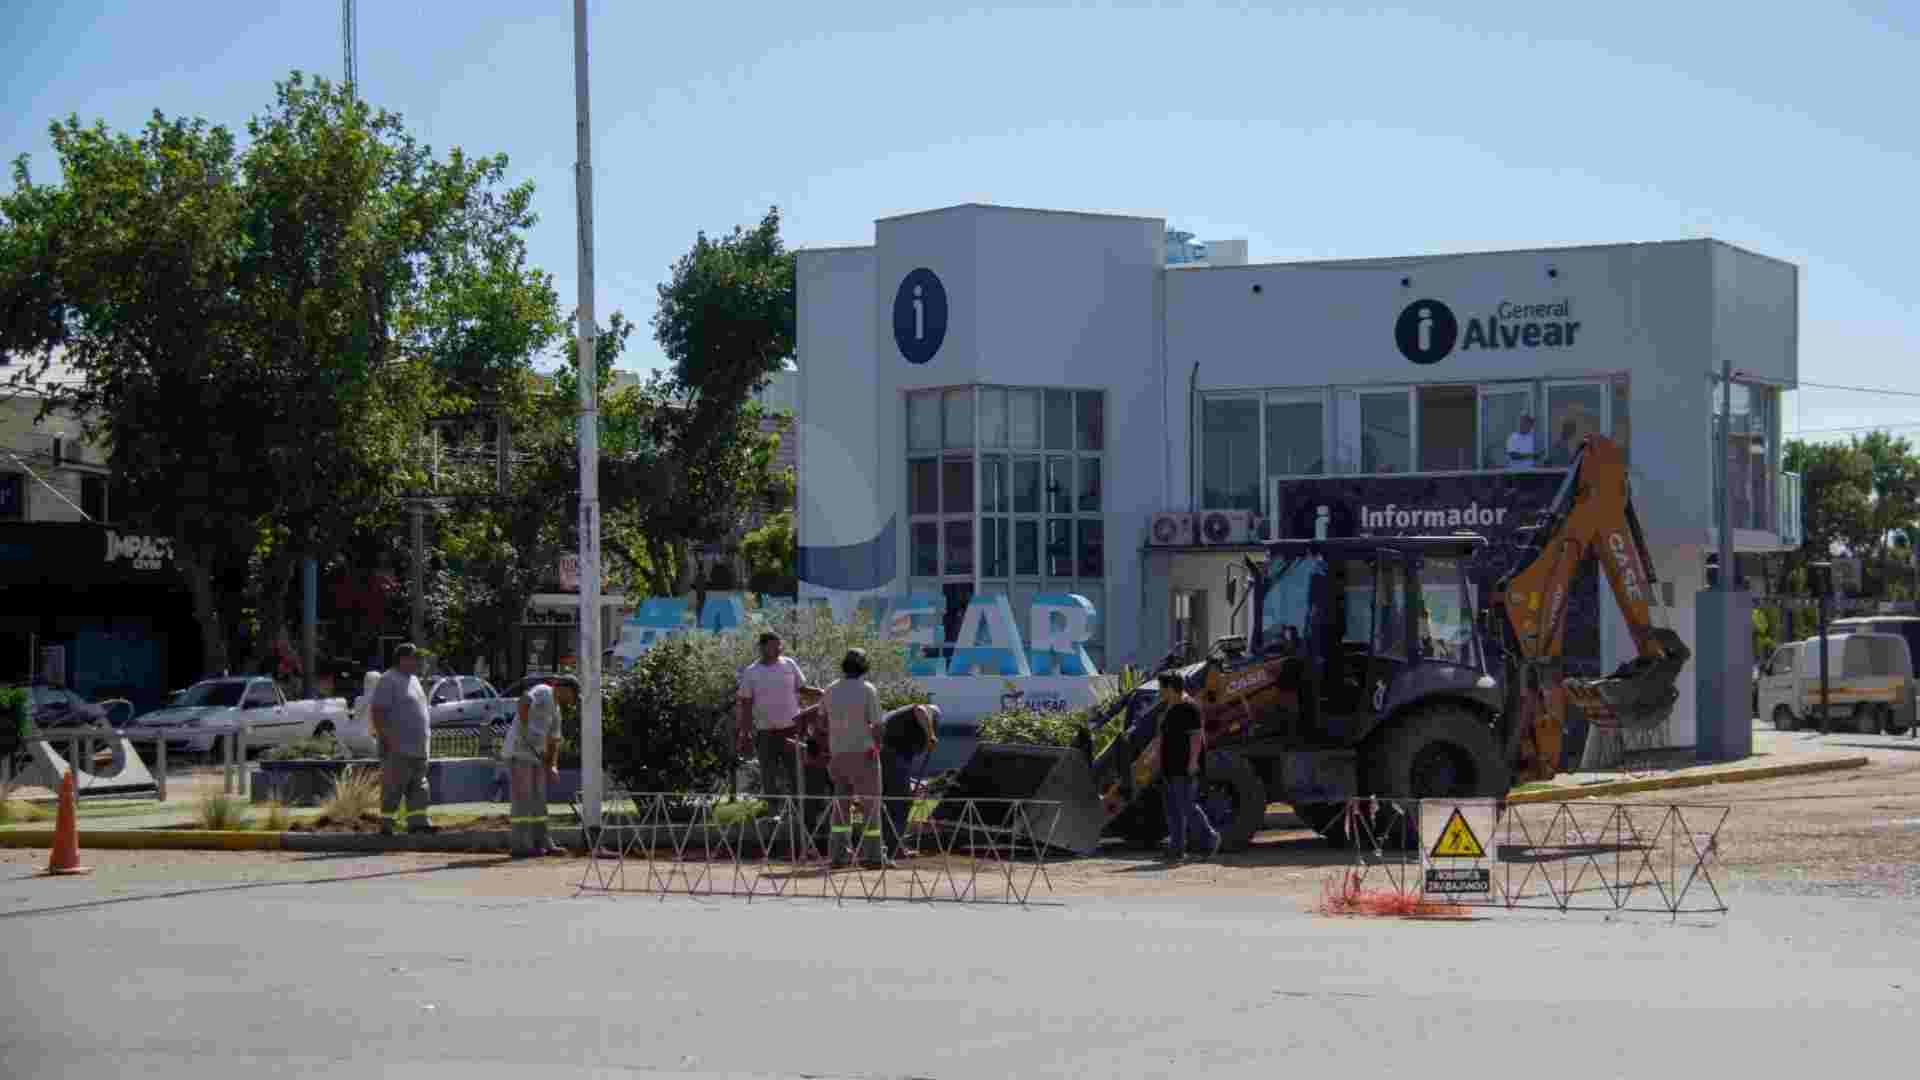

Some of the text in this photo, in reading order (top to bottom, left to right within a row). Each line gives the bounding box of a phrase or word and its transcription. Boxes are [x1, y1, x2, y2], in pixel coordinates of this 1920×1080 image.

[1499, 300, 1569, 319] General
[1462, 316, 1581, 350] Alvear
[1360, 501, 1508, 528] Informador
